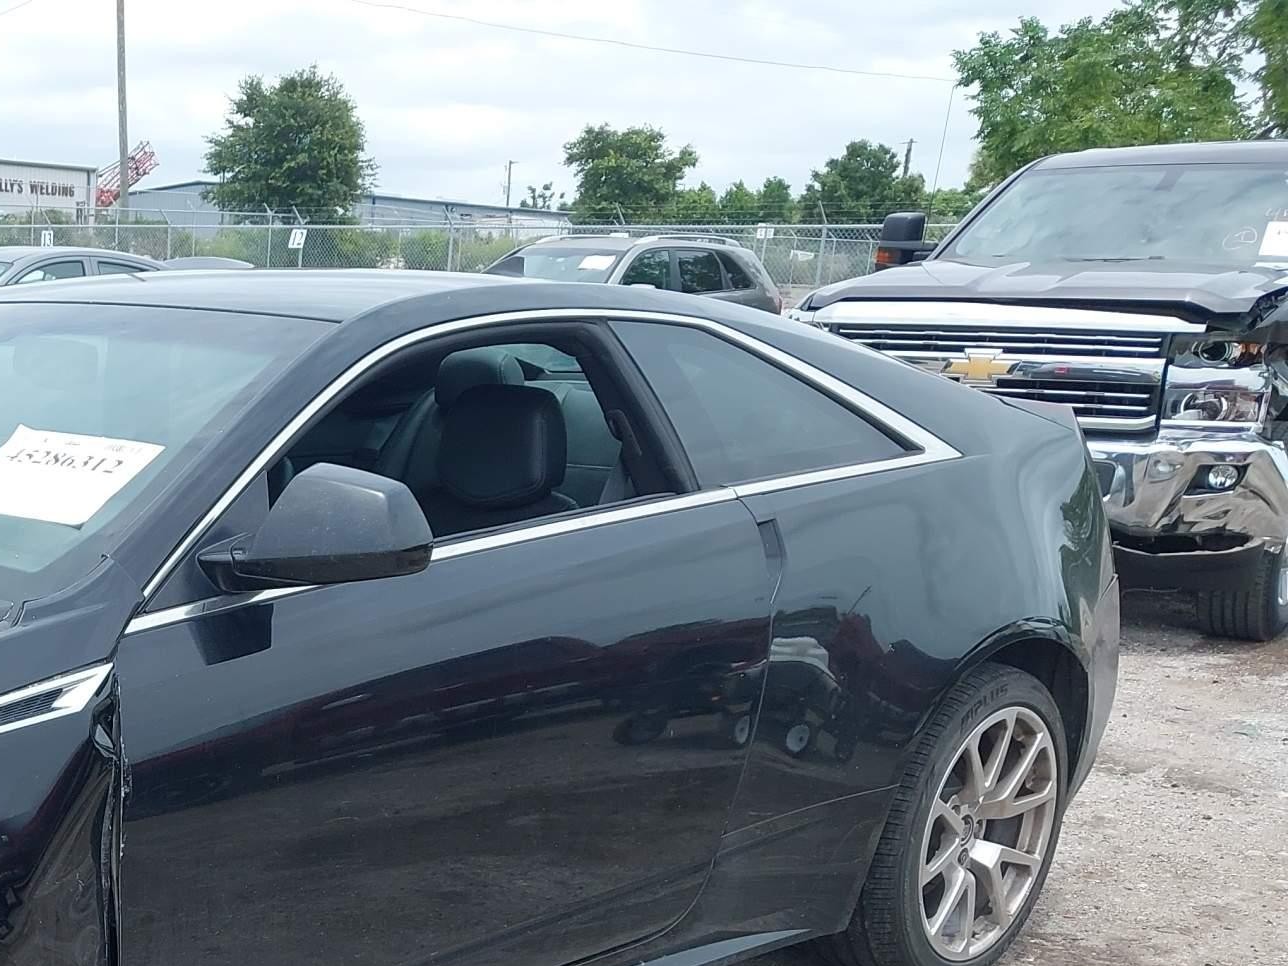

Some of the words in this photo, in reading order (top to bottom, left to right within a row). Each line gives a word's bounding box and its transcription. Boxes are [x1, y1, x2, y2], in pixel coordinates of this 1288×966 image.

[29, 180, 75, 198] WELDING
[42, 232, 52, 247] 13
[291, 230, 305, 246] 12
